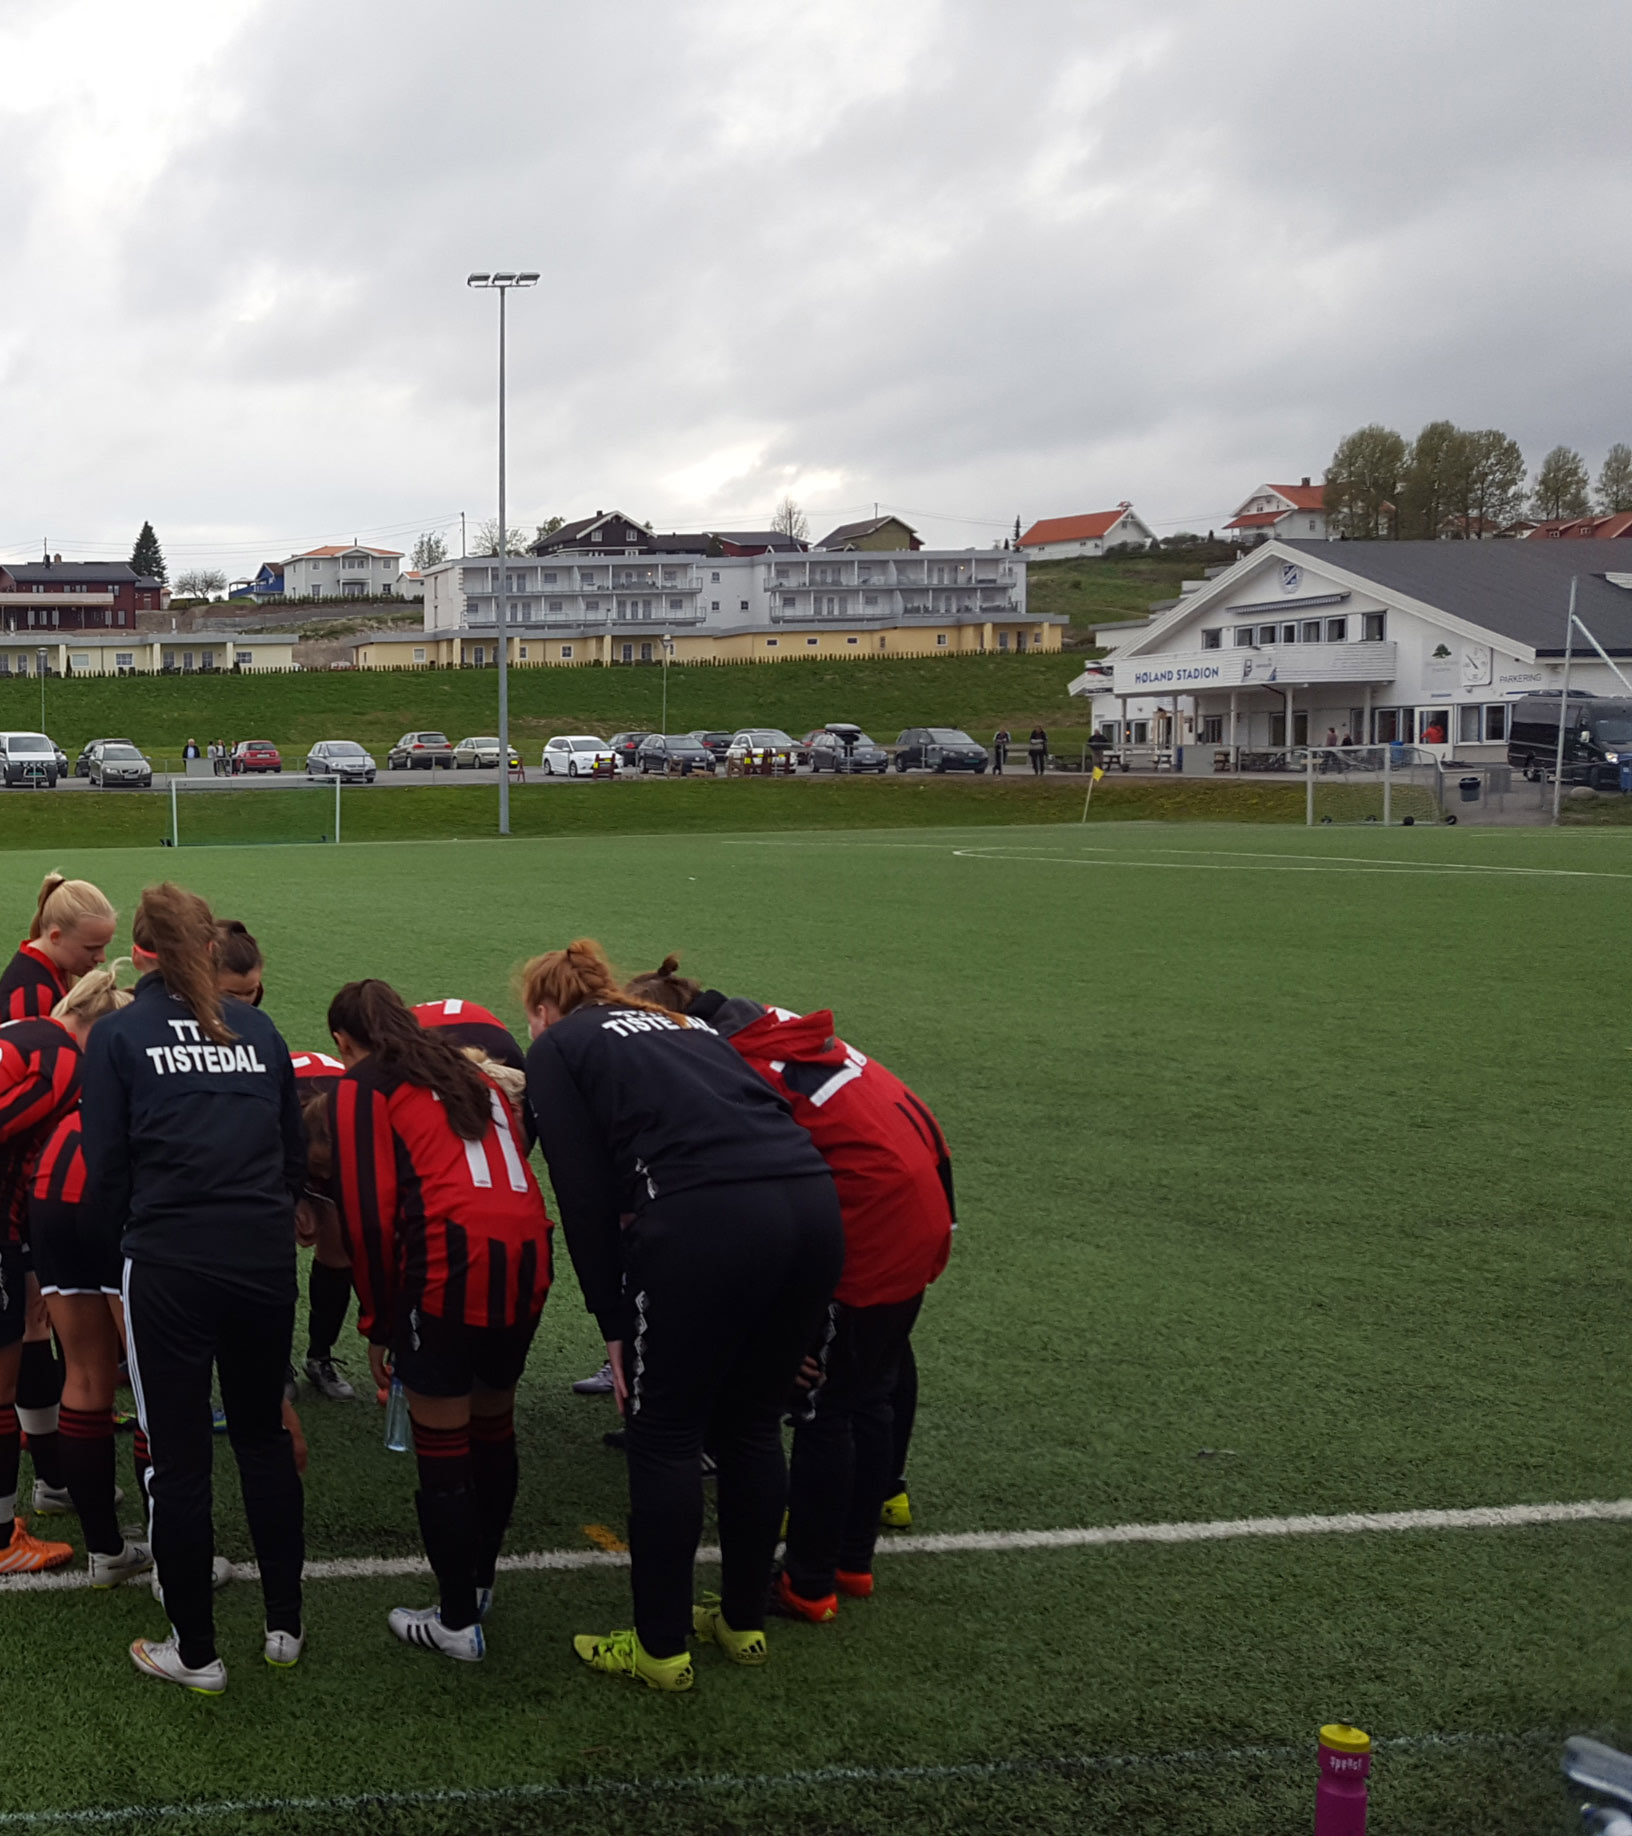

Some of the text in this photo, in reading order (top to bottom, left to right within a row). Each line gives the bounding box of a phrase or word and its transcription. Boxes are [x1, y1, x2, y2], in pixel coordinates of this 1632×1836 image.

[1134, 666, 1219, 684] HØLAND STADION
[1499, 673, 1543, 684] PARKERING
[601, 1014, 719, 1038] TISTEAL
[145, 1044, 267, 1075] TISTEDAL
